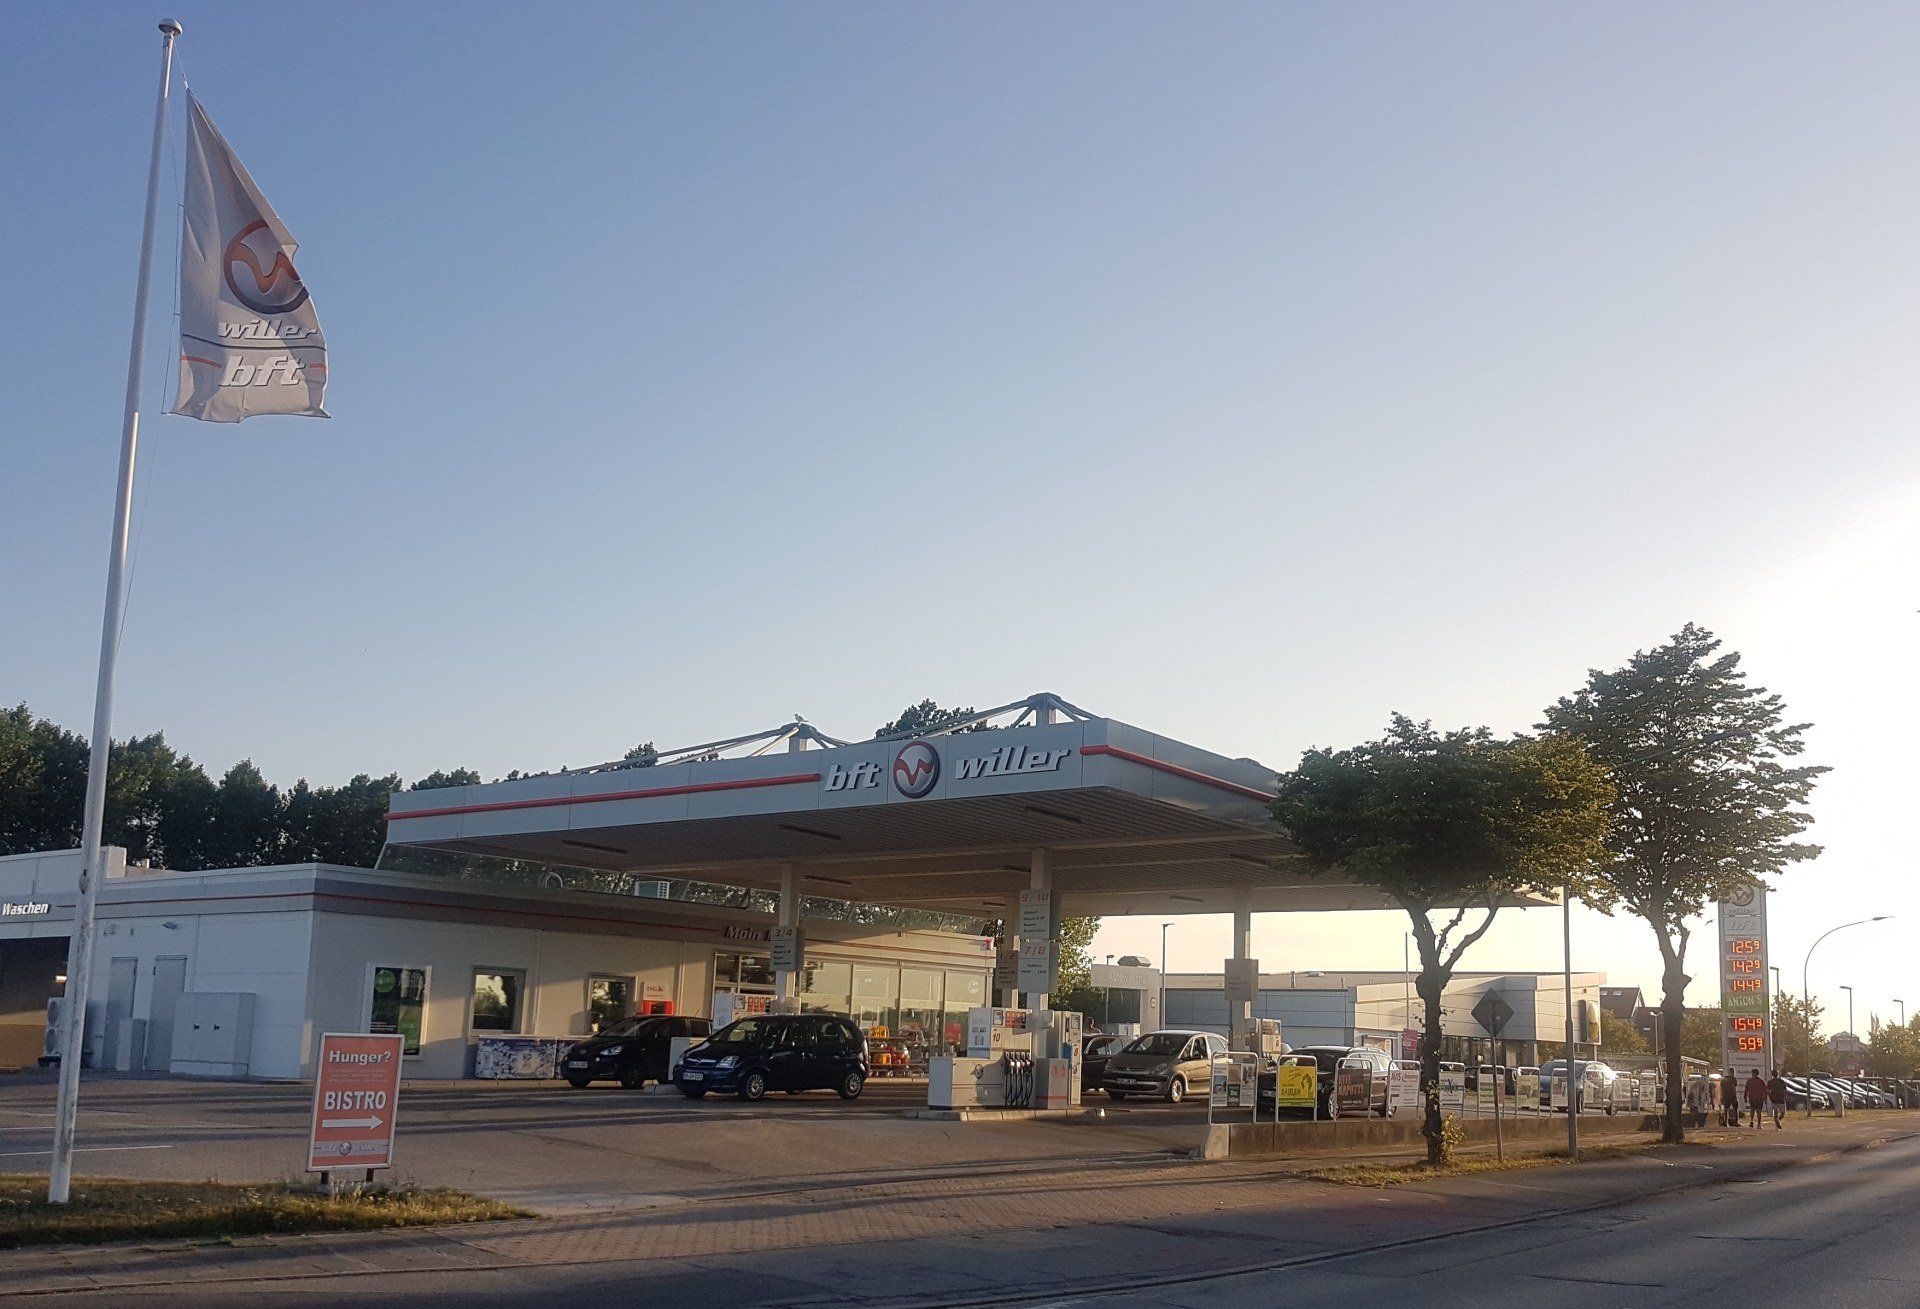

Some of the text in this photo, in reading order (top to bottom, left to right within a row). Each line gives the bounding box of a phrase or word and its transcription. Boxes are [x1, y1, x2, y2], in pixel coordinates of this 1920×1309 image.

[218, 319, 317, 340] willer
[218, 355, 306, 387] bft
[824, 745, 1073, 791] bft willer
[2, 902, 51, 916] Waschen
[725, 926, 761, 941] Moin
[1732, 940, 1760, 954] 1259
[1733, 960, 1761, 973] 1429
[1733, 979, 1761, 991] 1449
[1728, 994, 1762, 1007] ANTON'S
[1734, 1018, 1762, 1031] 1549
[992, 1033, 1000, 1042] 10
[1738, 1037, 1763, 1050] 599
[328, 1050, 392, 1066] Hunger?
[324, 1090, 387, 1111] BISTRO
